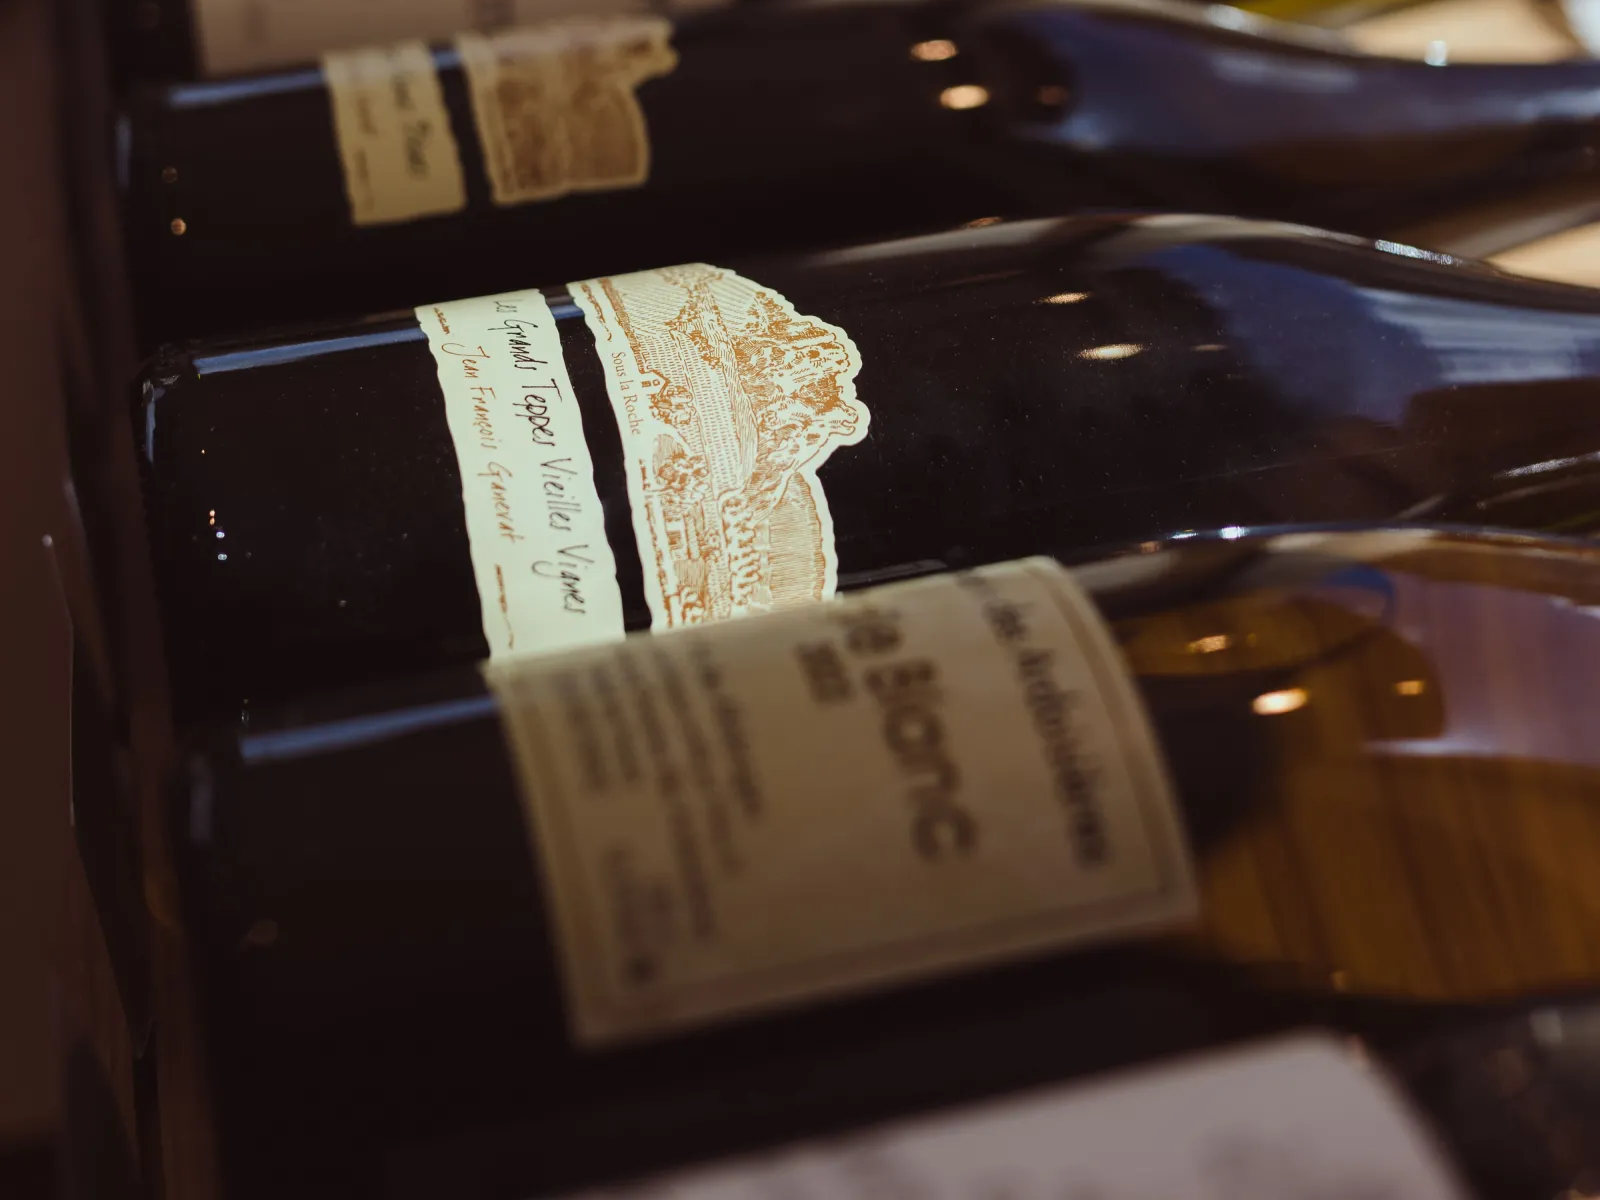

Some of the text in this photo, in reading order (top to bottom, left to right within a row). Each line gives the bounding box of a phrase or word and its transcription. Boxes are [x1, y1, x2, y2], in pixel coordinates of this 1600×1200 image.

[487, 318, 548, 371] Grands
[441, 343, 490, 379] Jean
[470, 385, 502, 450] François
[512, 377, 563, 448] Teppes
[611, 351, 644, 436] Sous la Roche
[539, 457, 582, 531] Vieilles
[531, 544, 595, 615] Vignes
